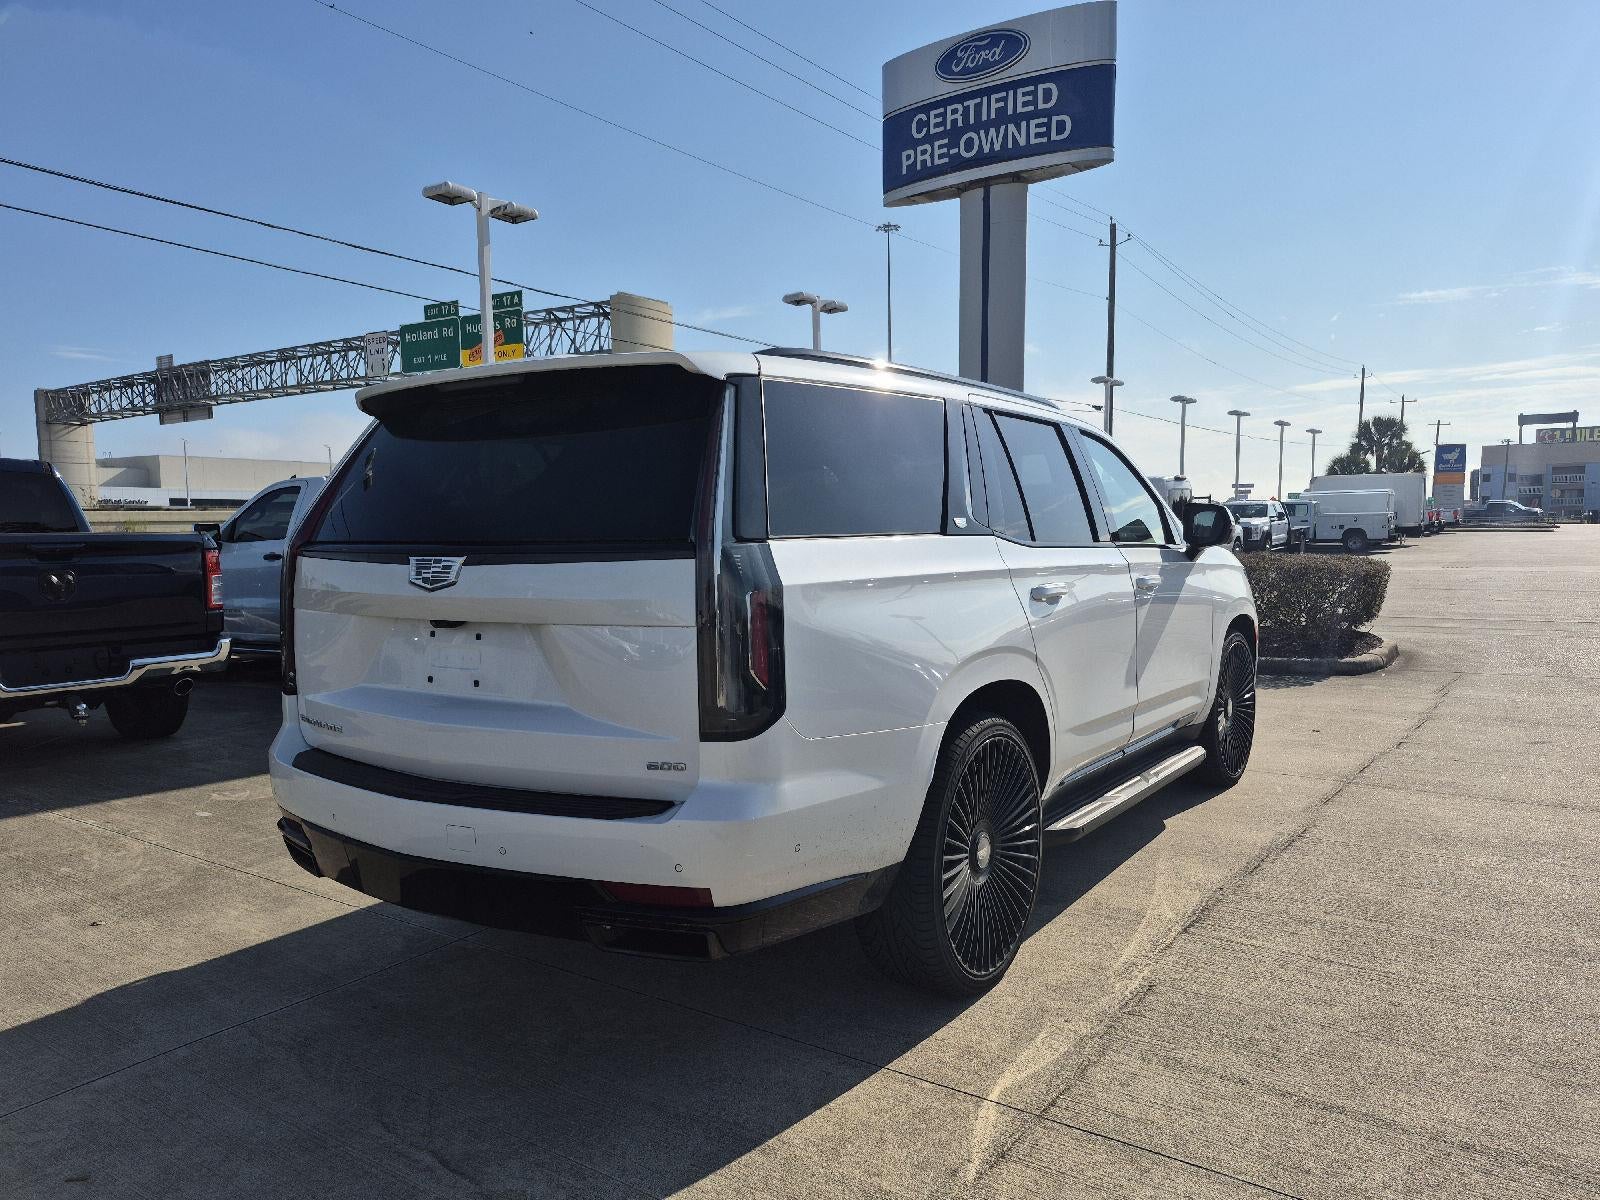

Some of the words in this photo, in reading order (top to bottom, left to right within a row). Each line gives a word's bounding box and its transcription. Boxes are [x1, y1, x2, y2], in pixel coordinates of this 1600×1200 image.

[951, 38, 1005, 73] Ford
[911, 82, 1059, 139] CERTIFIED
[901, 114, 1073, 175] PRE-OWNED
[502, 295, 512, 307] 17
[513, 294, 520, 305] A
[427, 307, 438, 316] EXIT
[441, 305, 449, 315] 17
[450, 304, 456, 314] B
[466, 320, 501, 335] Hugs
[504, 317, 517, 329] Rd
[405, 327, 439, 343] Holland
[442, 325, 454, 338] Rd
[367, 336, 387, 346] SPEED
[369, 347, 385, 356] LIMIT
[497, 349, 516, 358] ONLY
[413, 356, 425, 364] EXIT
[434, 353, 448, 363] MILE
[646, 761, 687, 771] 600
